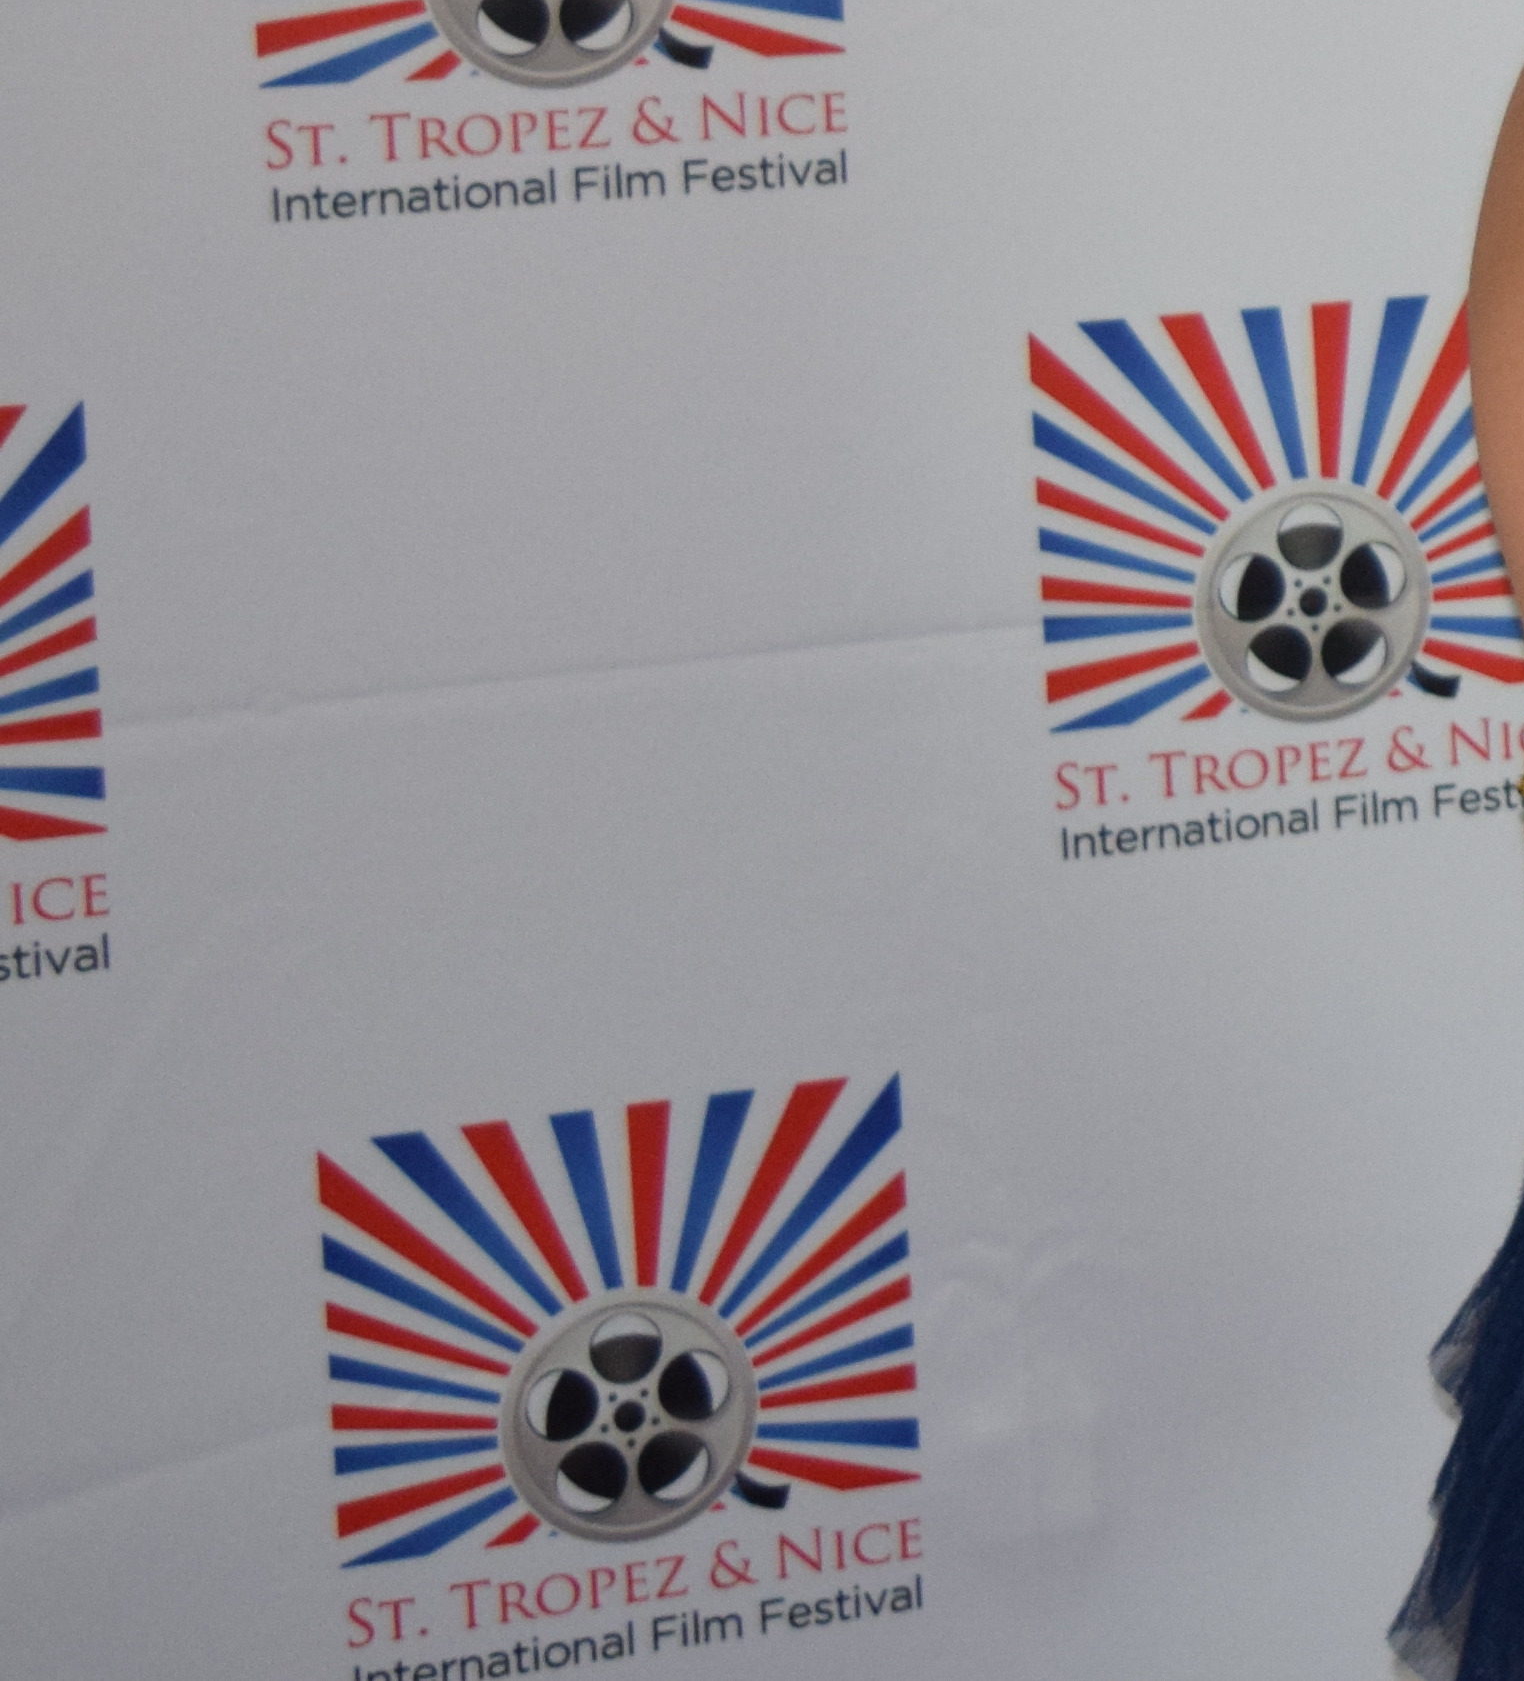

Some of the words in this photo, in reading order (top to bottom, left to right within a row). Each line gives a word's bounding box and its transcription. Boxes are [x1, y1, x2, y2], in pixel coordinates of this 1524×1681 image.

[264, 119, 348, 171] ST.
[369, 105, 610, 163] TROPEZ
[630, 97, 680, 146] &
[699, 91, 847, 142] NICE
[272, 168, 556, 223] International
[573, 163, 666, 201] Film
[683, 149, 847, 194] Festival
[1054, 761, 1130, 811] ST.
[1148, 737, 1368, 800] TROPEZ
[1385, 725, 1432, 774] &
[1061, 799, 1318, 861] International
[1334, 791, 1418, 829] Film
[346, 1597, 428, 1649] ST.
[449, 1554, 689, 1631] TROPEZ
[707, 1540, 758, 1590] &
[776, 1519, 921, 1580] NICE
[651, 1611, 743, 1652] Film
[760, 1575, 923, 1634] Festival
